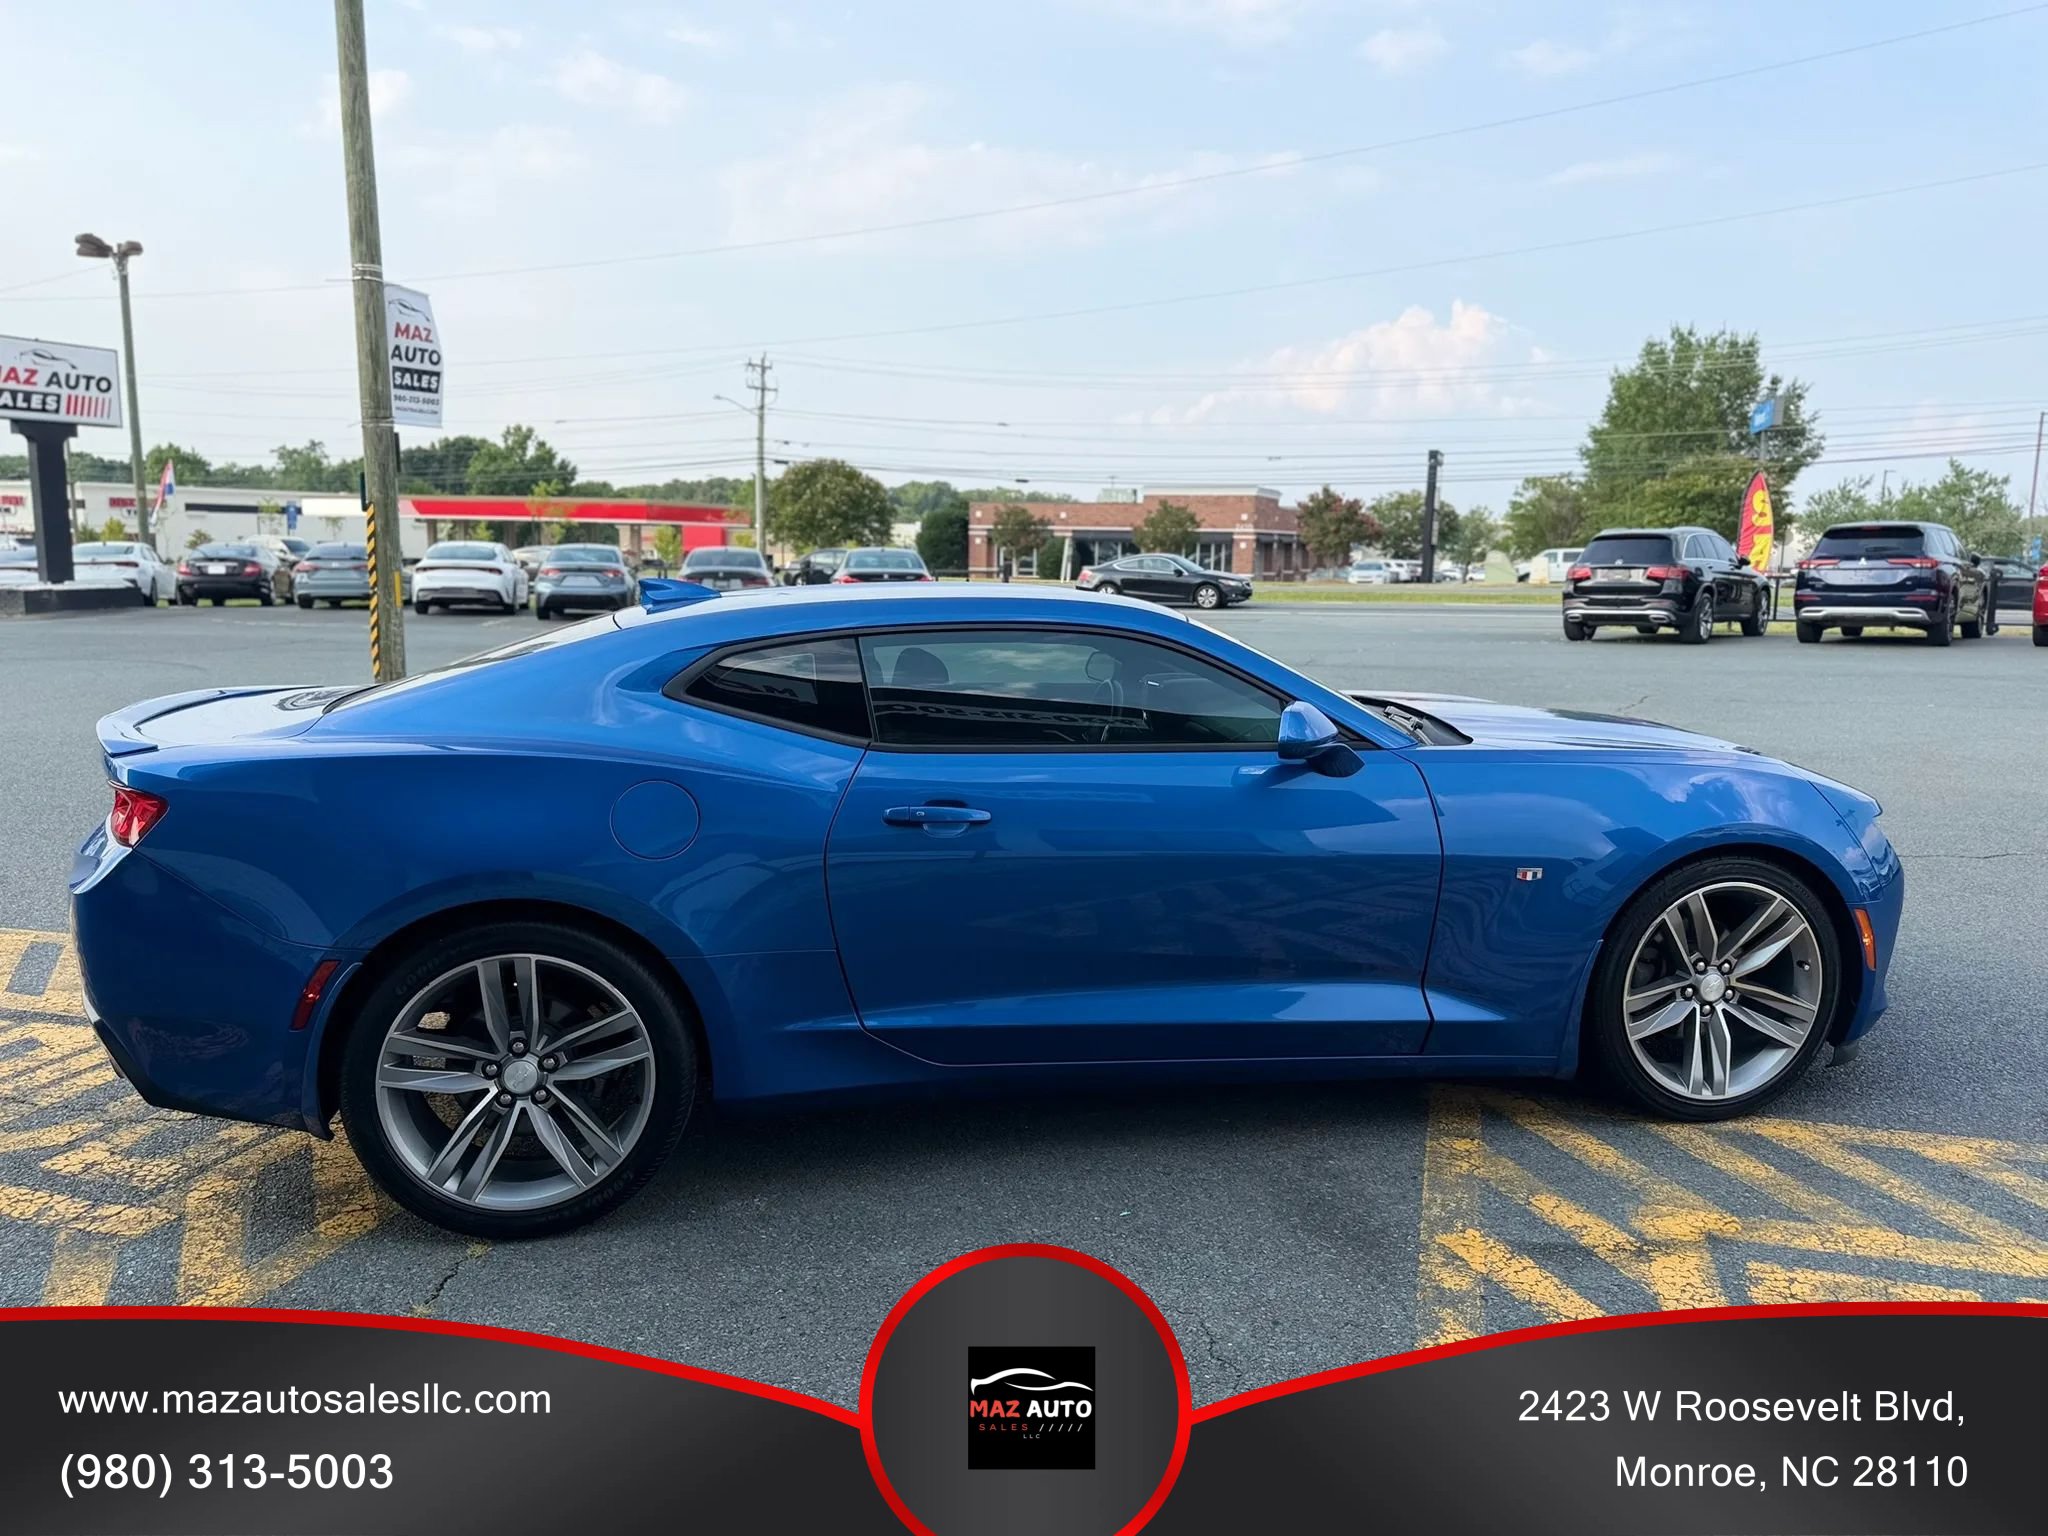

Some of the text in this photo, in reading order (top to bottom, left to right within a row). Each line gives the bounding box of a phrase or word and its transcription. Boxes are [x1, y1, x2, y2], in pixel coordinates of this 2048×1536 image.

[394, 322, 433, 343] MAZ
[391, 344, 441, 366] AUTO
[0, 365, 112, 393] AZ AUTO
[394, 371, 438, 390] SALES
[0, 390, 59, 412] ALES
